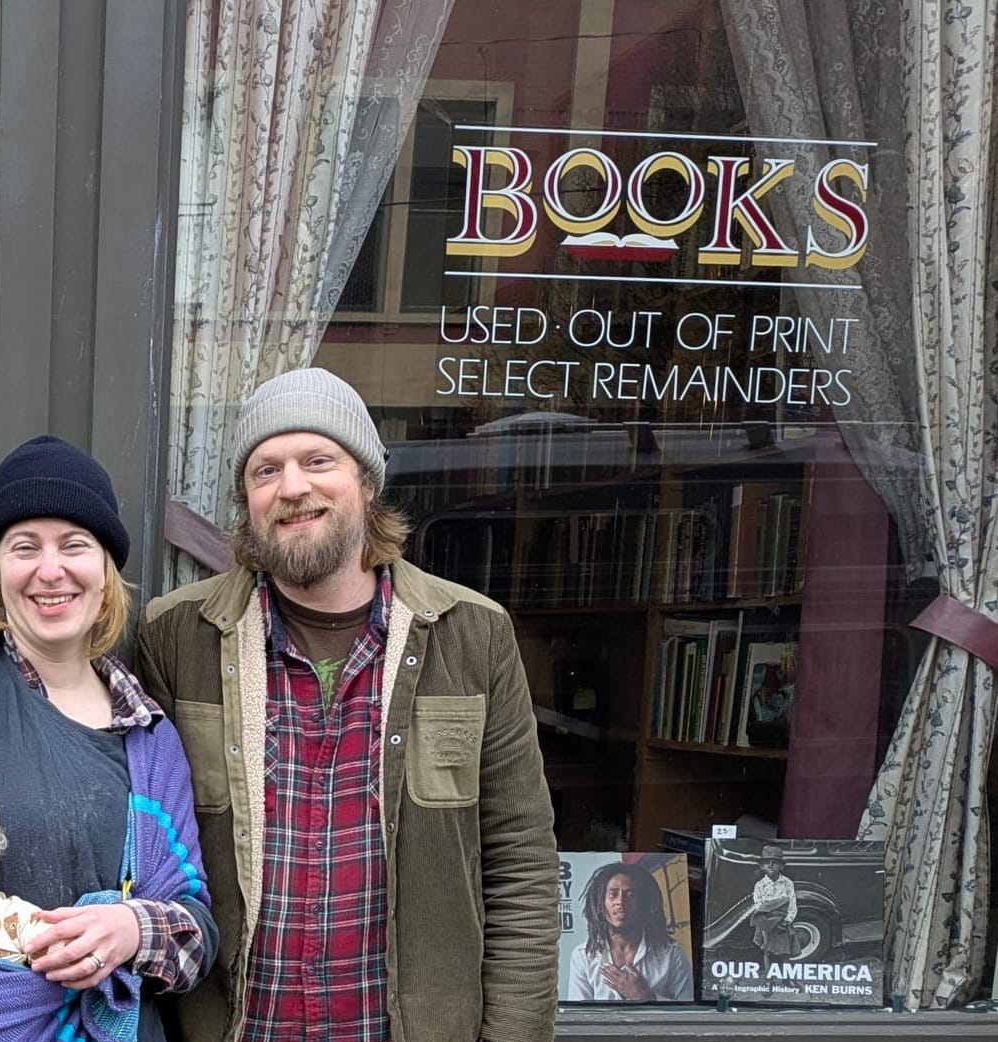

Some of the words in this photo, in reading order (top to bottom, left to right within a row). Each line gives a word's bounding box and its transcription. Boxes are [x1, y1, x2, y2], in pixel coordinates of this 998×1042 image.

[446, 145, 869, 270] BOOKS
[440, 305, 547, 345] USED
[569, 308, 662, 348] OUT
[676, 312, 735, 351] OF
[749, 315, 859, 355] PRINT
[436, 356, 580, 400] SELECT
[592, 362, 851, 406] REMAINDERS
[711, 960, 760, 979] OUR
[767, 962, 873, 982] AMERICA
[772, 985, 800, 994] History
[805, 984, 828, 994] KEN
[832, 985, 872, 995] BURNS
